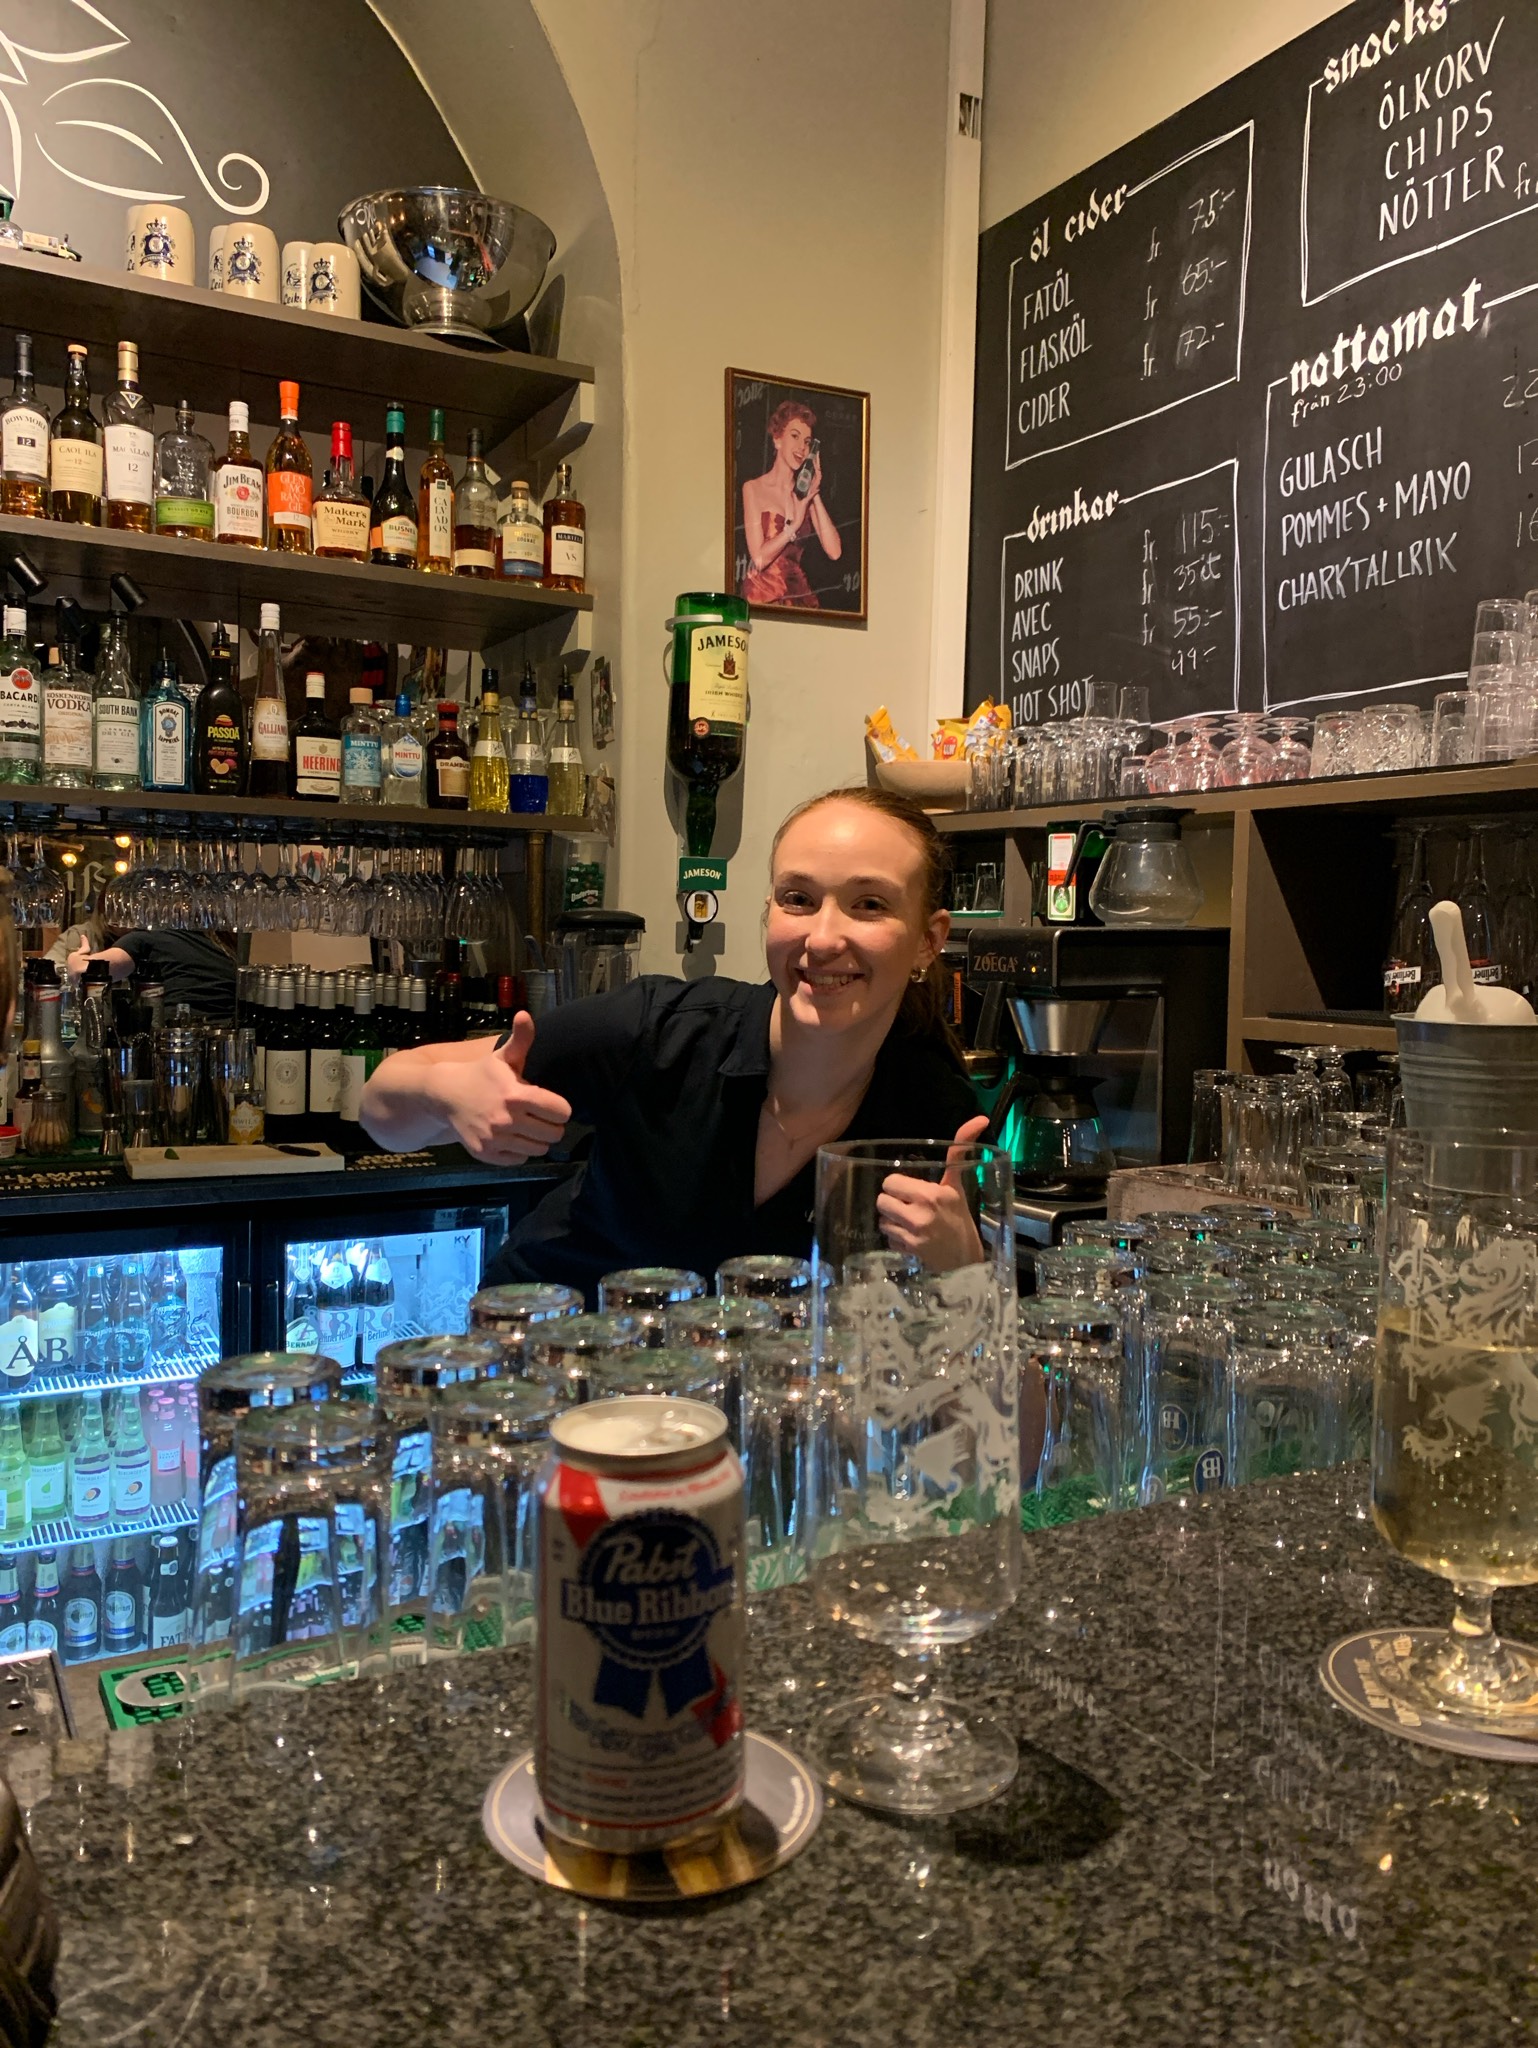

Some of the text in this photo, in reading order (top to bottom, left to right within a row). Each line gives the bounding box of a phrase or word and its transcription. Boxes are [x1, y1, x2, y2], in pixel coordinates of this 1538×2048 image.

[1324, 0, 1448, 94] snacks
[1379, 15, 1505, 131] ÖLKORV
[1385, 90, 1493, 180] CHIPS
[1379, 144, 1506, 242] NÖTTER
[1029, 184, 1127, 262] öl cider
[1023, 268, 1074, 330] FATÖL
[1021, 312, 1092, 383] FLASKÖL
[1289, 277, 1481, 396] nattamat
[1338, 362, 1402, 404] 23:00
[1019, 382, 1070, 434] CIDER
[21, 438, 32, 446] 12
[1279, 426, 1382, 497] GULASCH
[128, 462, 138, 472] 12
[223, 473, 261, 491] JIM BEAM
[227, 506, 259, 518] BOURBON
[324, 506, 367, 518] Maker's
[336, 516, 367, 528] Mark
[1026, 488, 1119, 543] drinkar
[1282, 491, 1370, 556] POMMES
[1377, 497, 1388, 512] +
[1396, 460, 1470, 519] MAYO
[1015, 557, 1064, 602] DRINK
[1278, 531, 1457, 611] CHARKTALLRIK
[697, 634, 748, 654] JAMESO
[1012, 602, 1052, 642] AVEC
[1012, 637, 1060, 683] SNAPS
[47, 698, 91, 713] VODKA
[98, 704, 119, 715] SOUTH
[1013, 689, 1043, 727] HOT
[1048, 675, 1094, 717] SHOT
[350, 740, 379, 749] MINTTU
[395, 751, 421, 760] MINTTU
[683, 867, 721, 880] JAMESON
[1393, 968, 1416, 983] Berliner
[1473, 967, 1500, 982] Berliner
[602, 1533, 699, 1585] Pabst
[565, 1580, 634, 1626] Blue
